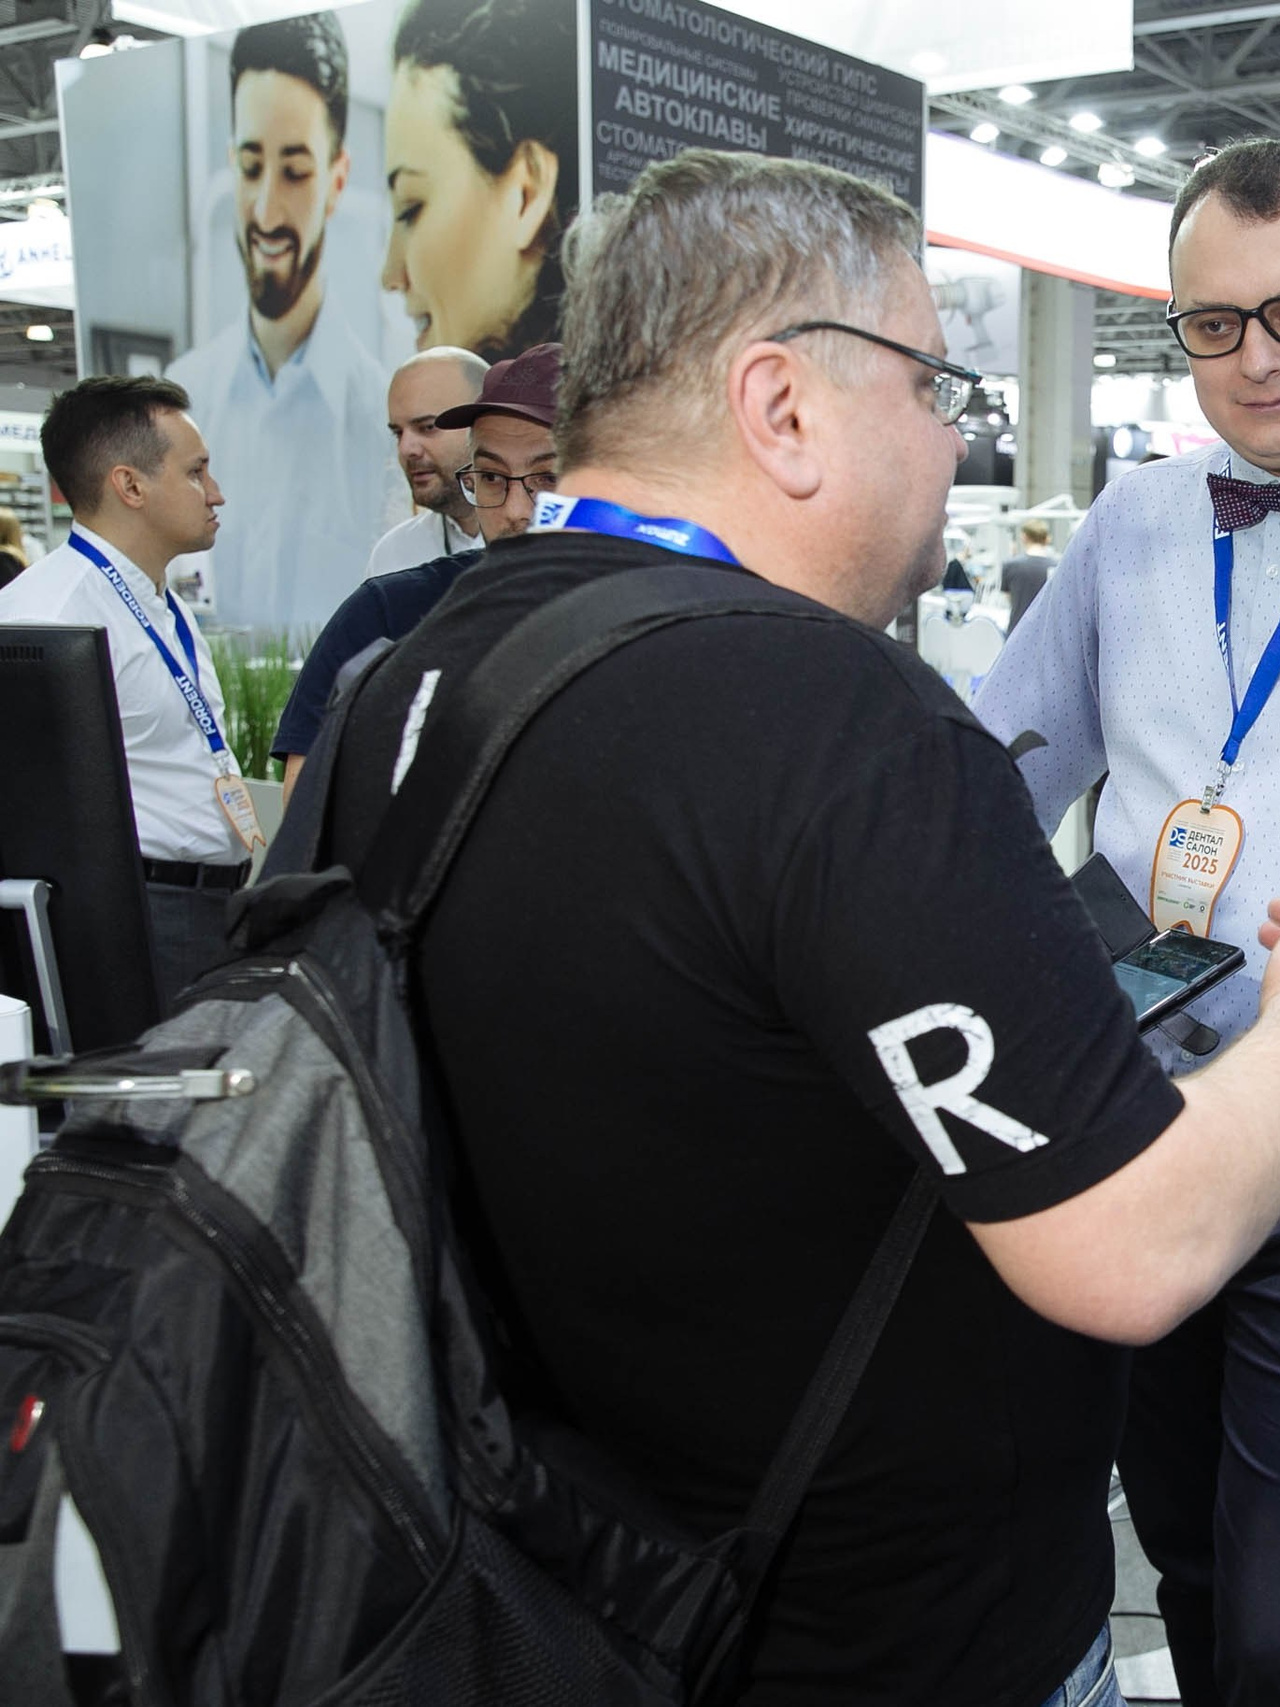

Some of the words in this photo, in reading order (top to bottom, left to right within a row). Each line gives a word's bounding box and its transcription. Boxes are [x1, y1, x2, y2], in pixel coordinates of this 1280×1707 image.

[603, 0, 829, 78] ОМАТОЛОГИЧЕСКИЙ
[832, 60, 878, 96] ГИПС
[598, 40, 782, 122] МЕДИЦИНСКИЕ
[614, 85, 768, 151] АВТОКЛАВЫ
[784, 114, 917, 172] ХИРУРГИЧЕСКИЕ
[101, 563, 150, 628] FORDENT
[176, 673, 216, 736] FORDENT
[1182, 852, 1219, 876] 2025
[1186, 842, 1218, 857] САЛОН
[1188, 830, 1224, 847] ДЕНТАЛ
[867, 1003, 1050, 1175] R
